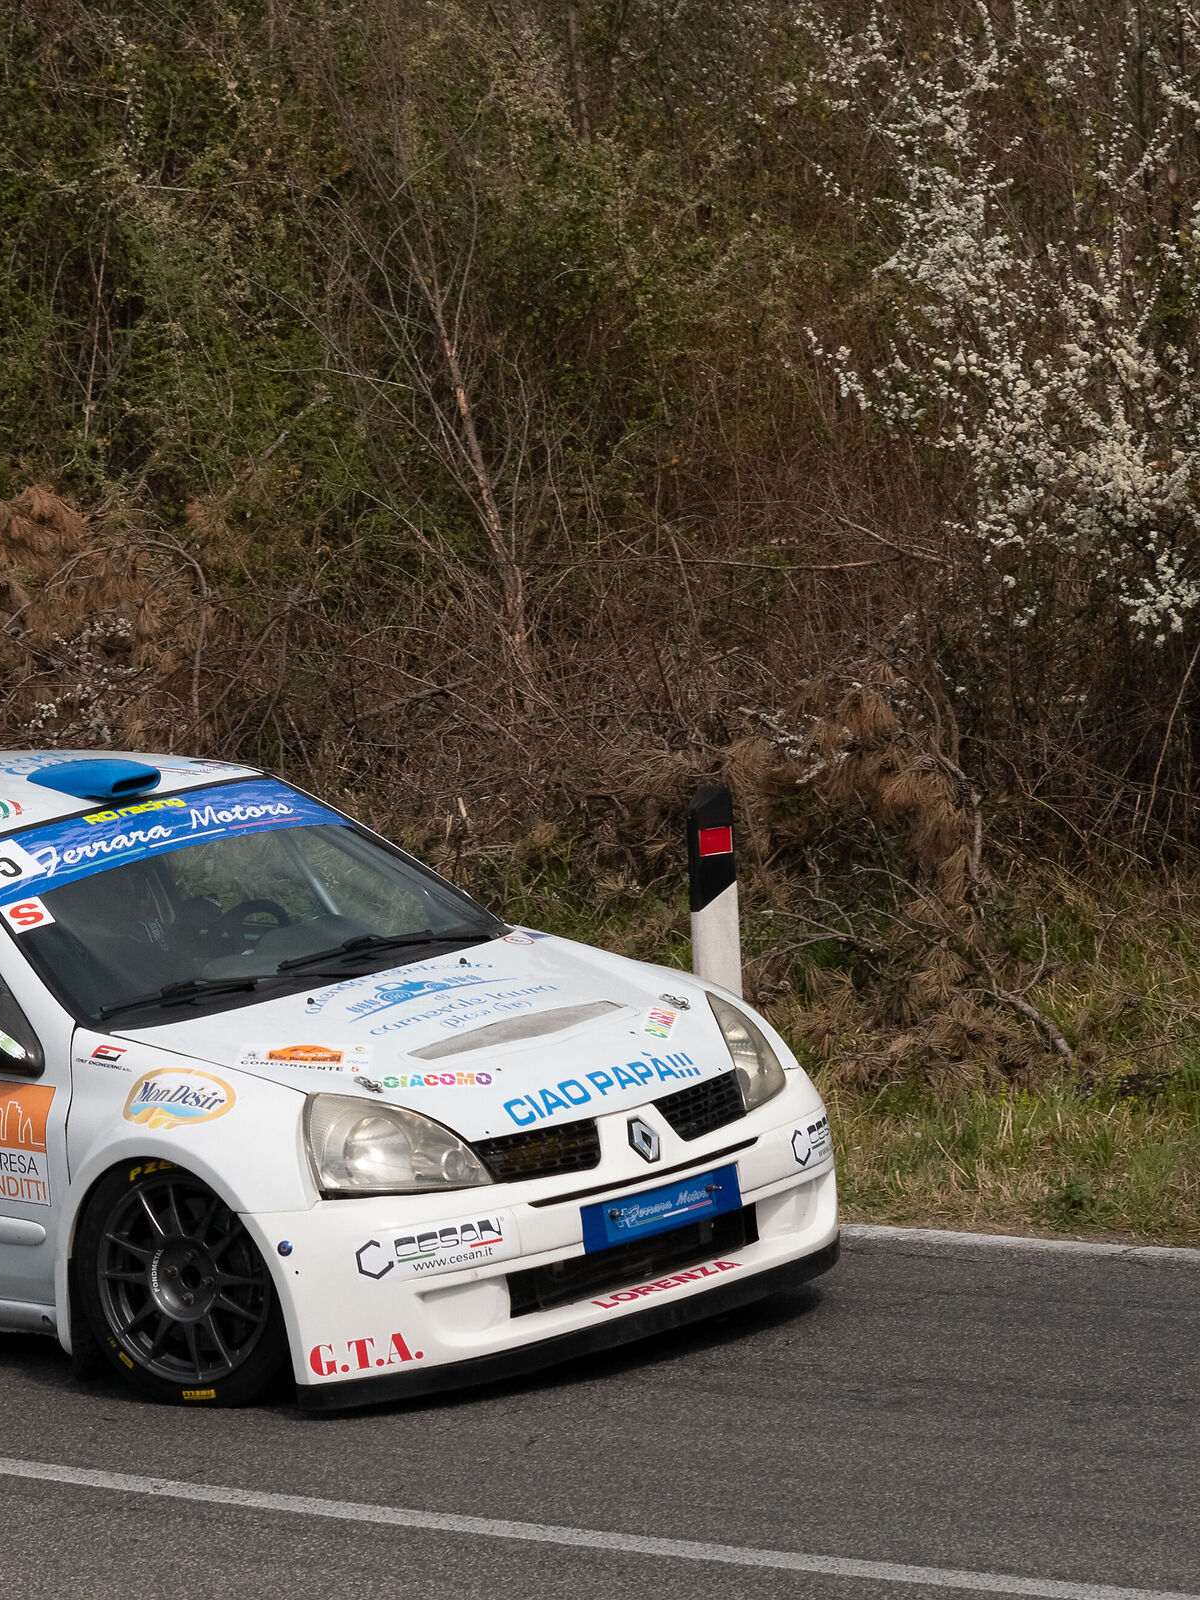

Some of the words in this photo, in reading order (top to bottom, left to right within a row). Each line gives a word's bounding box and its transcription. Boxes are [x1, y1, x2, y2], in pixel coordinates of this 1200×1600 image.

[117, 798, 187, 818] racing
[31, 825, 172, 877] Ferrara
[190, 803, 294, 829] Motors
[9, 903, 44, 926] S
[240, 1061, 344, 1072] CONCORRENTE
[383, 1072, 493, 1089] GIACOMO
[135, 1081, 171, 1104] Mon
[168, 1085, 225, 1110] Désir
[503, 1079, 591, 1127] CIAO
[585, 1051, 701, 1097] PAPÀ!!!
[393, 1217, 503, 1257] CESAN
[412, 1245, 494, 1272] www.cesan.it
[591, 1260, 744, 1309] LORENZA
[309, 1332, 424, 1377] G.T.A.
